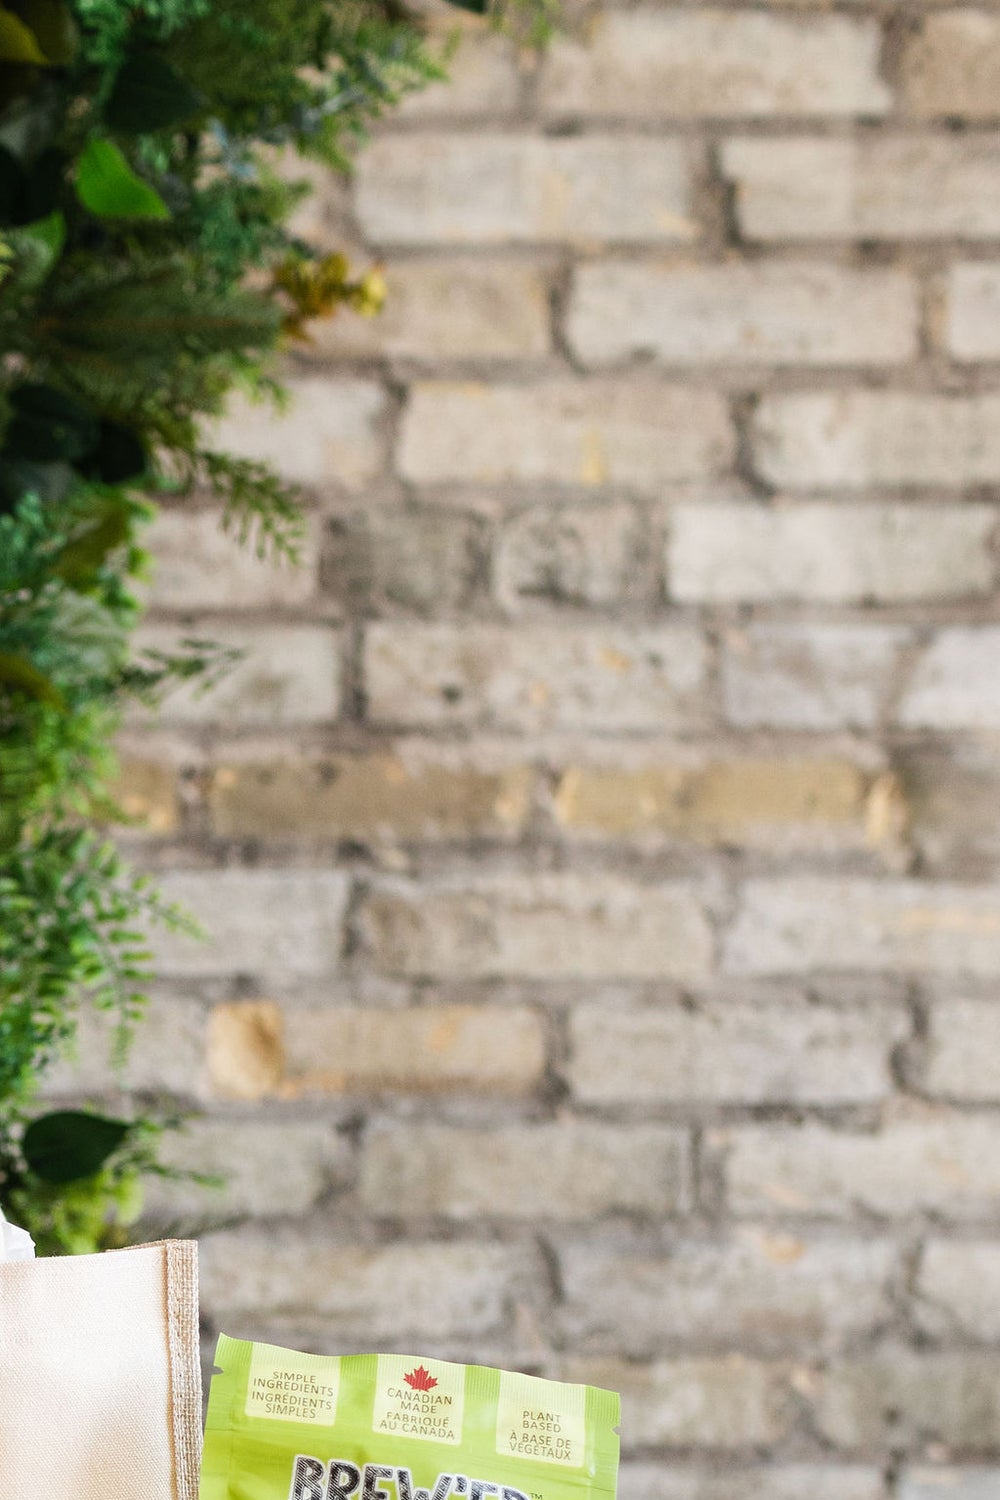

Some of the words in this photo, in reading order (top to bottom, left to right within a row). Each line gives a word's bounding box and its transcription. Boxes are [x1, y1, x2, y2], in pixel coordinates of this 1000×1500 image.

[272, 1371, 316, 1384] SIMPLE
[253, 1378, 334, 1397] INGREDIENTS
[251, 1391, 332, 1410] INGRÉDIENTS
[387, 1387, 452, 1405] CANADIAN
[265, 1403, 316, 1419] SIMPLES
[400, 1401, 437, 1414] MADE
[386, 1411, 450, 1428] FABRIQUÉ
[522, 1410, 560, 1423] PLANT
[379, 1420, 397, 1430] AU
[402, 1422, 455, 1440] CANADA
[523, 1420, 561, 1433] BASED
[522, 1433, 552, 1446] BASE
[556, 1438, 571, 1449] DE
